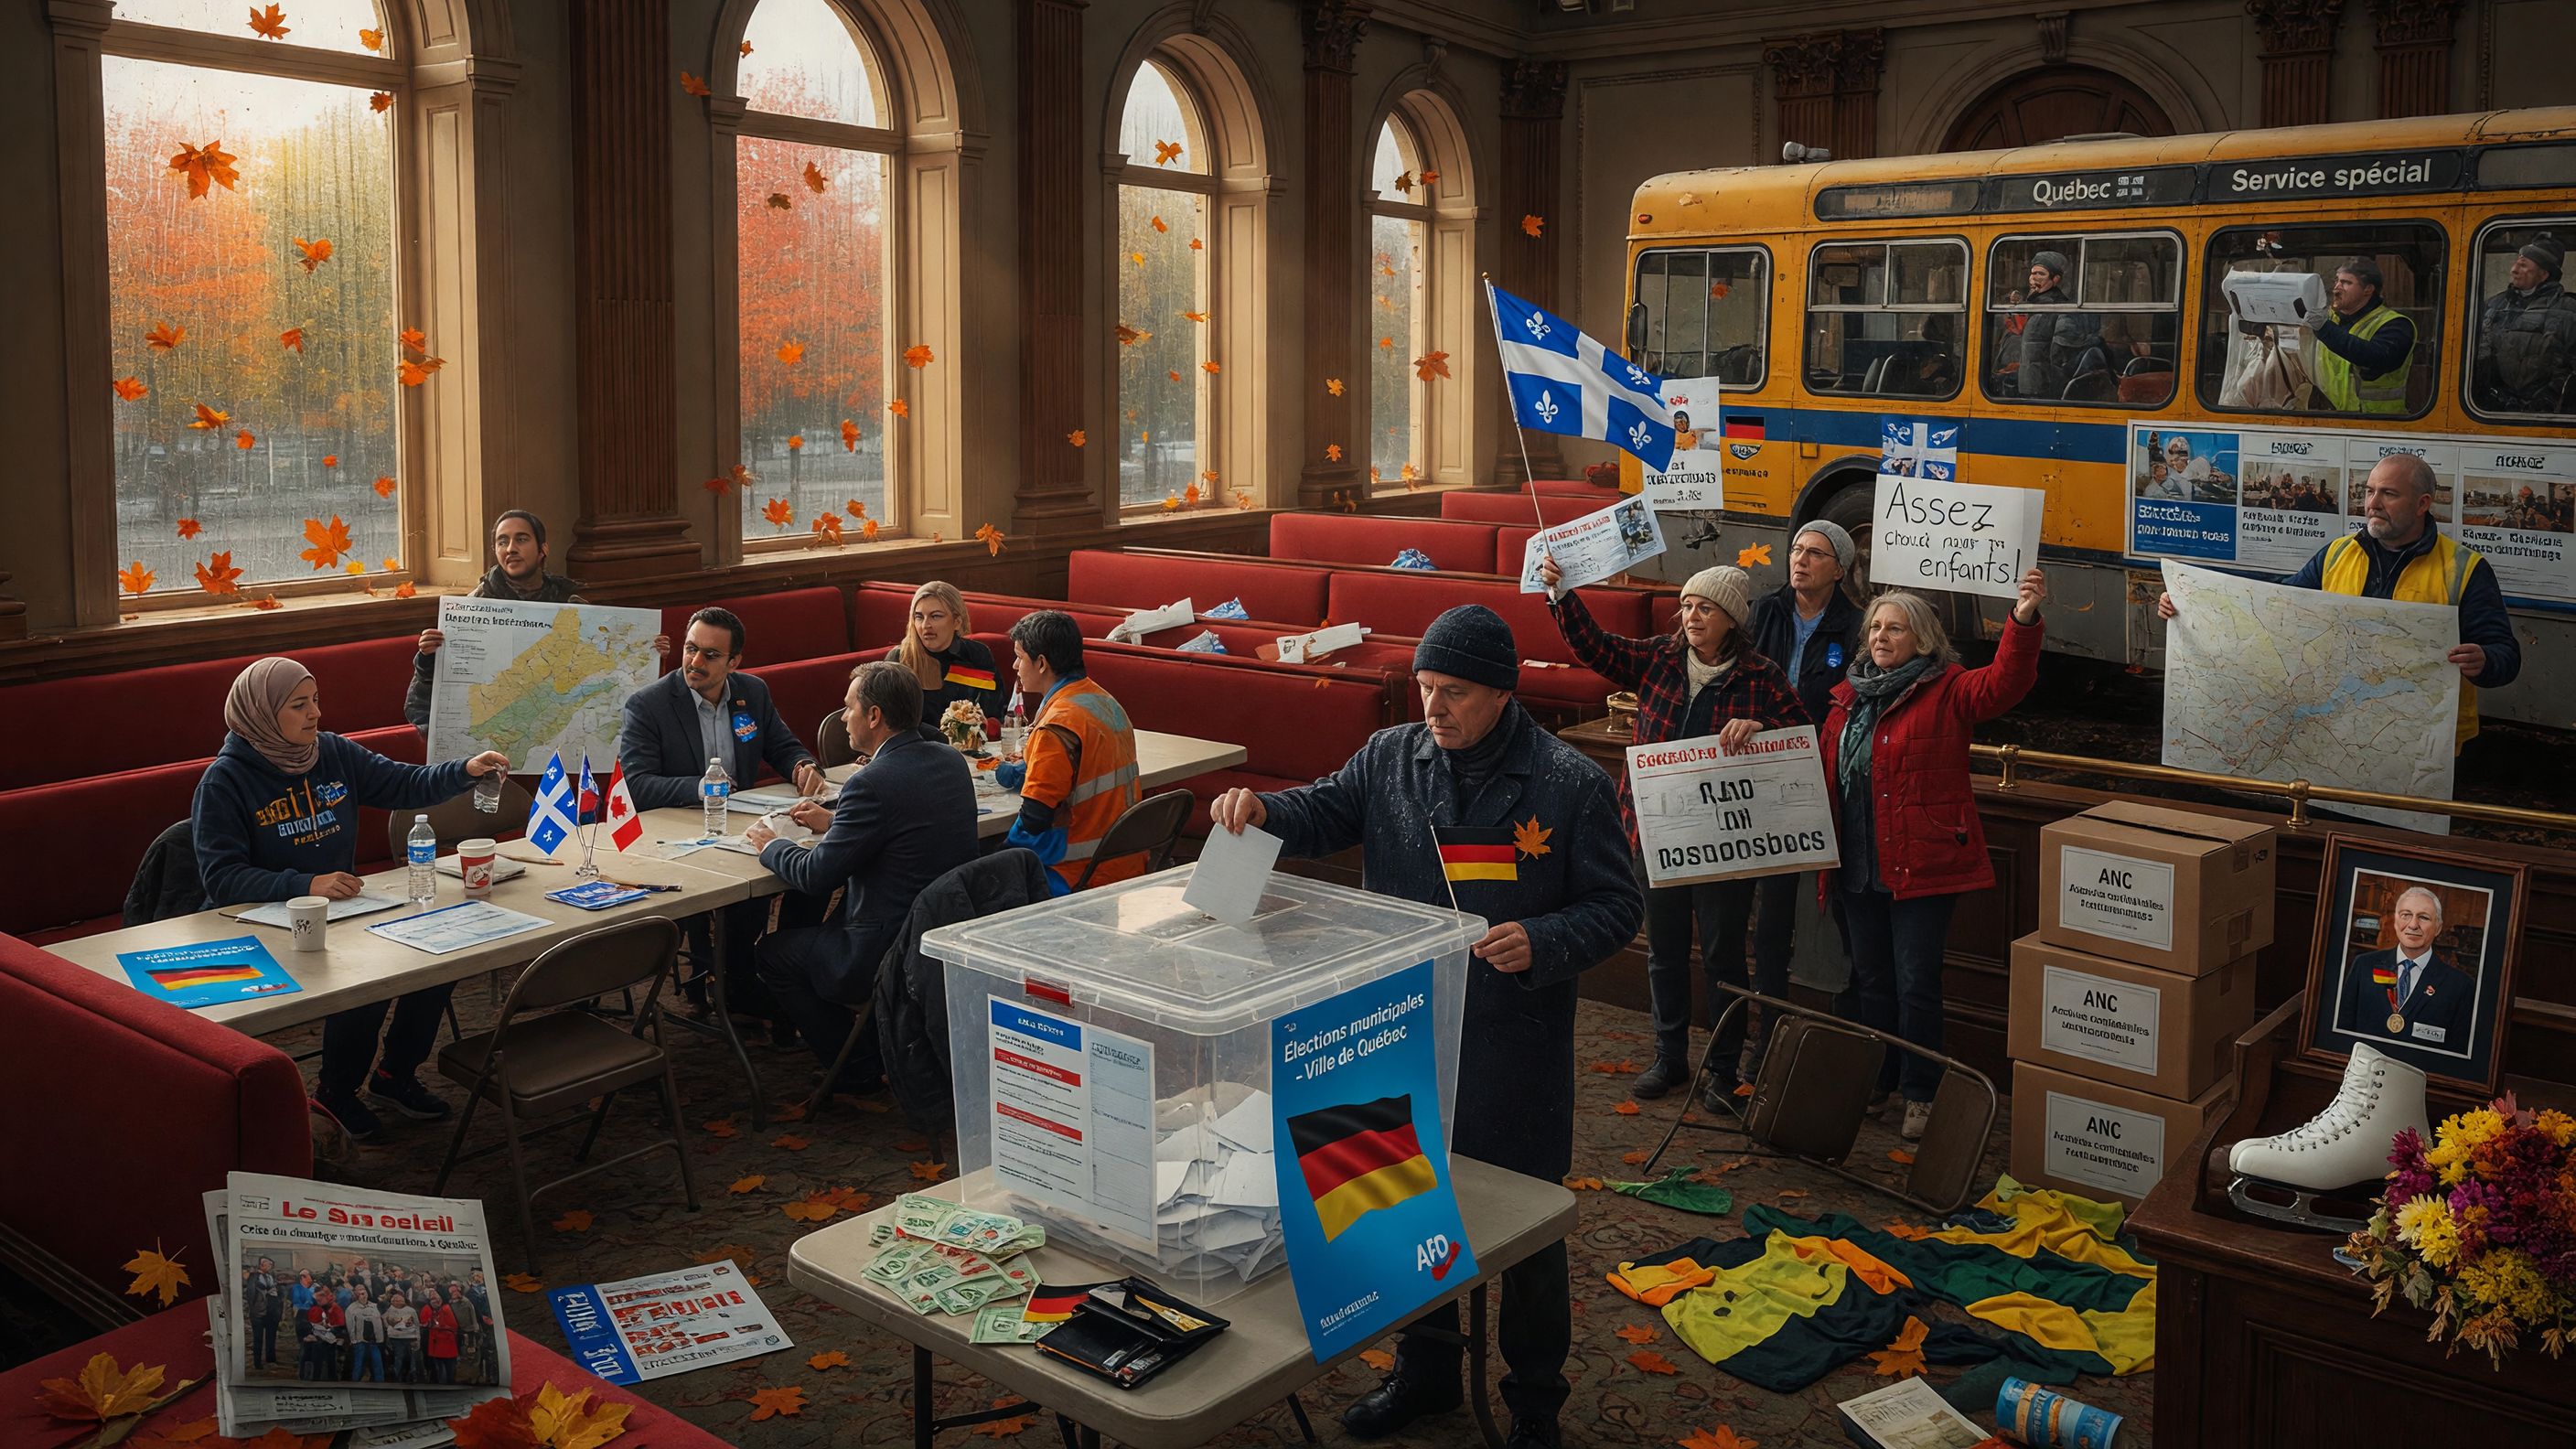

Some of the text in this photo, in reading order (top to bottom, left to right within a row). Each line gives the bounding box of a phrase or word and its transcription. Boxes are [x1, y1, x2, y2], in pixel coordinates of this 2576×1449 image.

[2231, 158, 2431, 192] Service spécial
[2033, 178, 2111, 207] Québec
[1885, 481, 1995, 532] Assez
[1919, 548, 2022, 584] enfants!
[2098, 867, 2133, 890] ANC
[2083, 989, 2118, 1013] ANC
[1284, 993, 1424, 1063] Élections municipales
[1304, 1055, 1336, 1080] Ville
[1337, 1046, 1355, 1066] de
[1357, 1025, 1408, 1057] Québec
[2086, 1116, 2121, 1140] ANC
